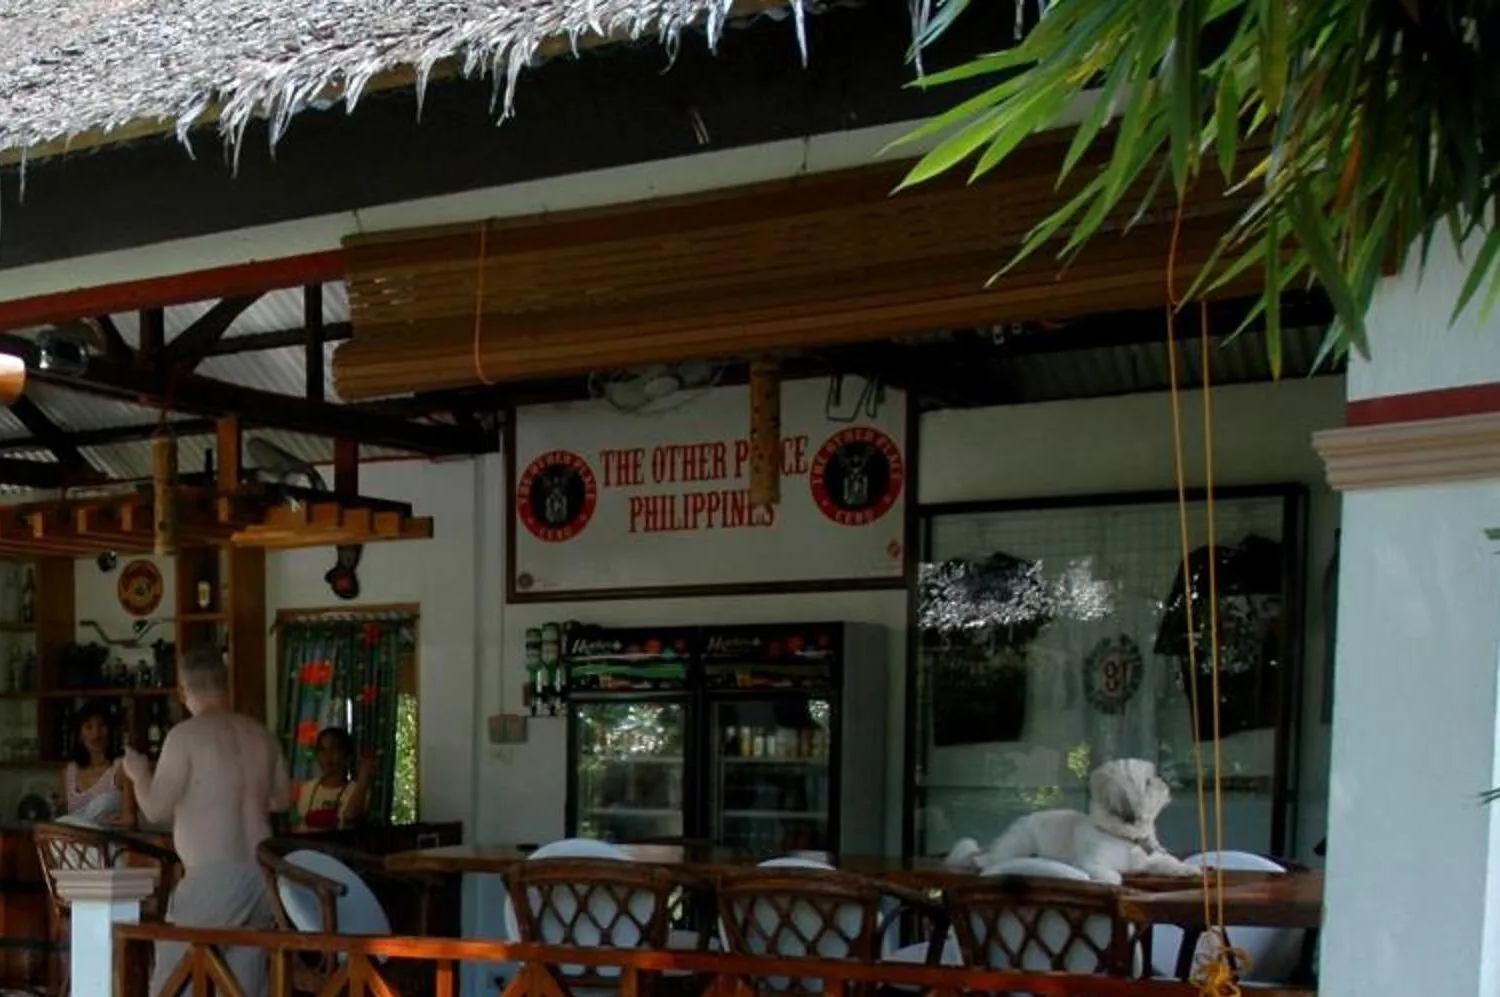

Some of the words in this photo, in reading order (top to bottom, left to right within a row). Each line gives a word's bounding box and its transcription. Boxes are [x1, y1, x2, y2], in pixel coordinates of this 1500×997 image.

[600, 448, 645, 487] THE
[652, 442, 726, 482] OTHER
[734, 435, 809, 478] PCE
[628, 489, 775, 533] PHILIPPINES
